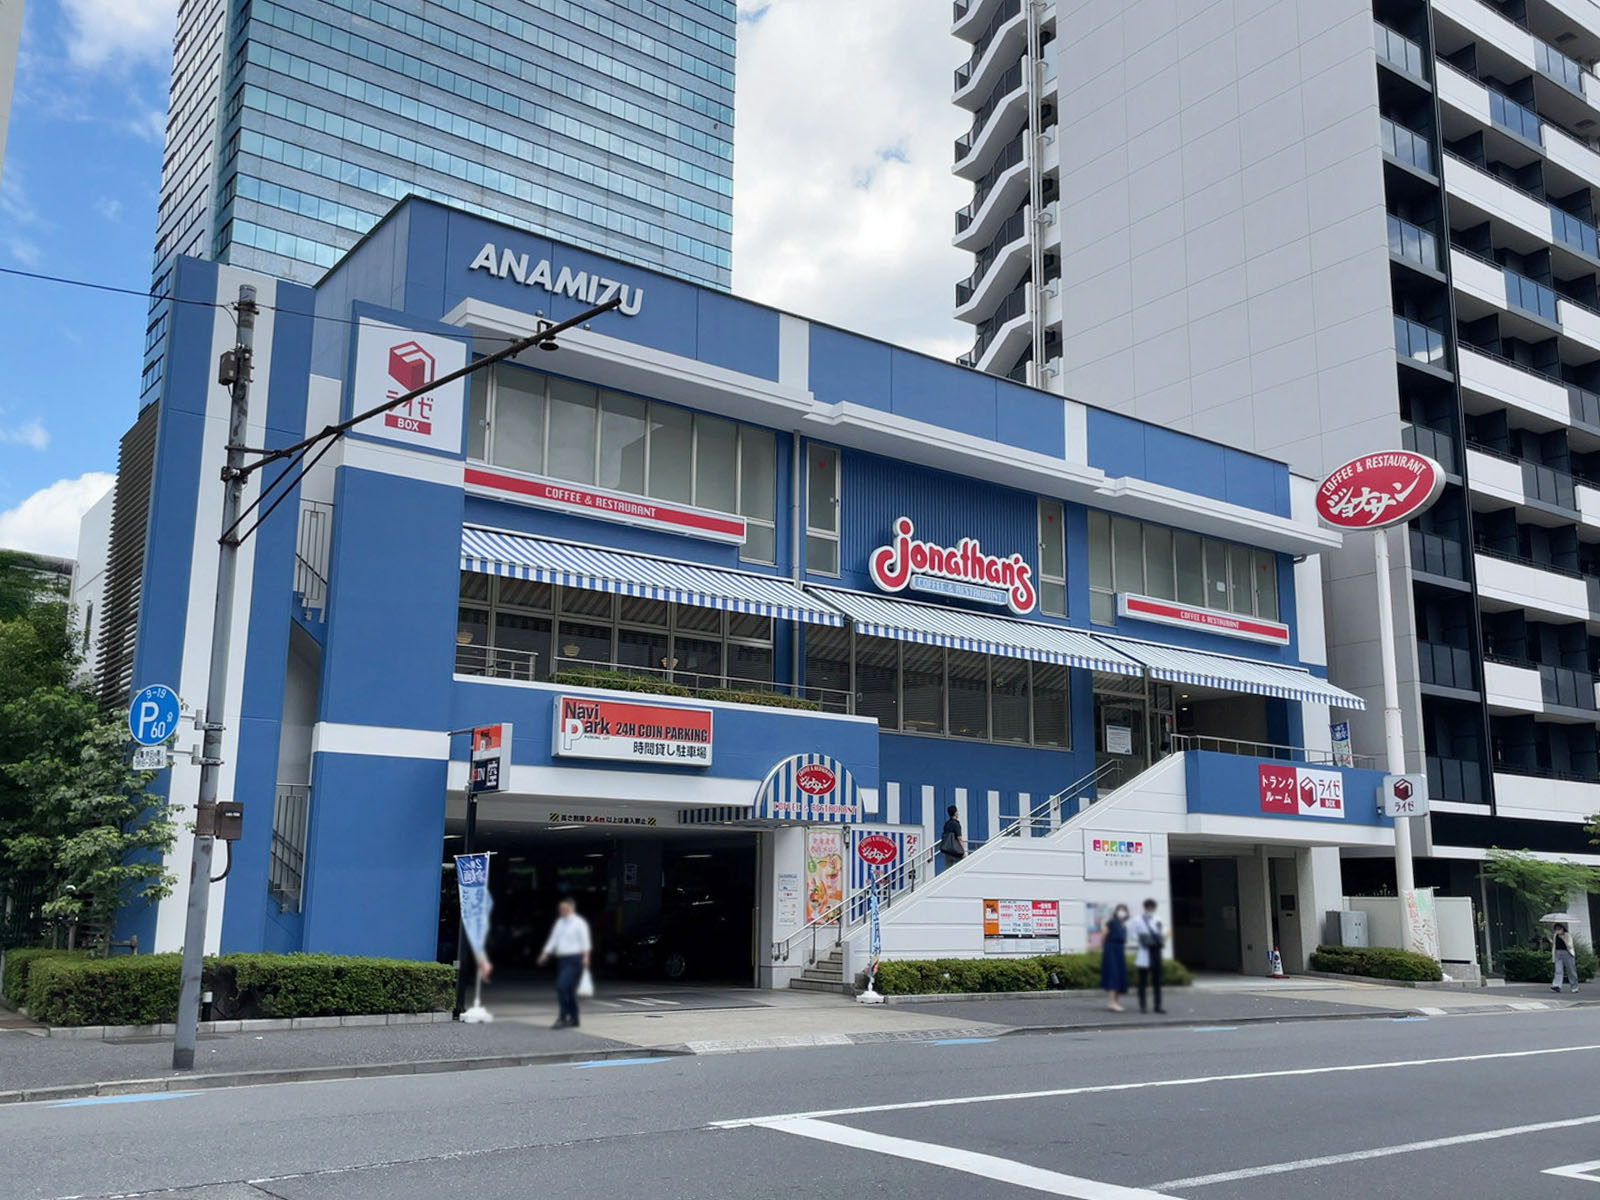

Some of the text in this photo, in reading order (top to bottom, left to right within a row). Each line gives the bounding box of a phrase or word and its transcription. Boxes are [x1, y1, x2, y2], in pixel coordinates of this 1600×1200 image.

[469, 242, 643, 316] ANAMIZU
[397, 418, 419, 431] BOX
[1321, 455, 1427, 496] COFFEE & RESTAURANT
[545, 487, 656, 517] COFFEE & RESTAURANT
[917, 578, 944, 592] COFFEE
[955, 585, 1002, 601] RESTAURANT
[146, 688, 167, 699] 9-19
[138, 701, 160, 739] P
[150, 721, 166, 739] 60
[565, 701, 599, 720] Navi
[564, 717, 708, 750] Park 24H COIN PARKING
[633, 741, 707, 759] 時間貸し駐車場
[1262, 774, 1294, 790] トランク
[1319, 779, 1341, 798] ライゼ
[1265, 791, 1292, 804] ルーム
[1394, 801, 1415, 812] ライゼ
